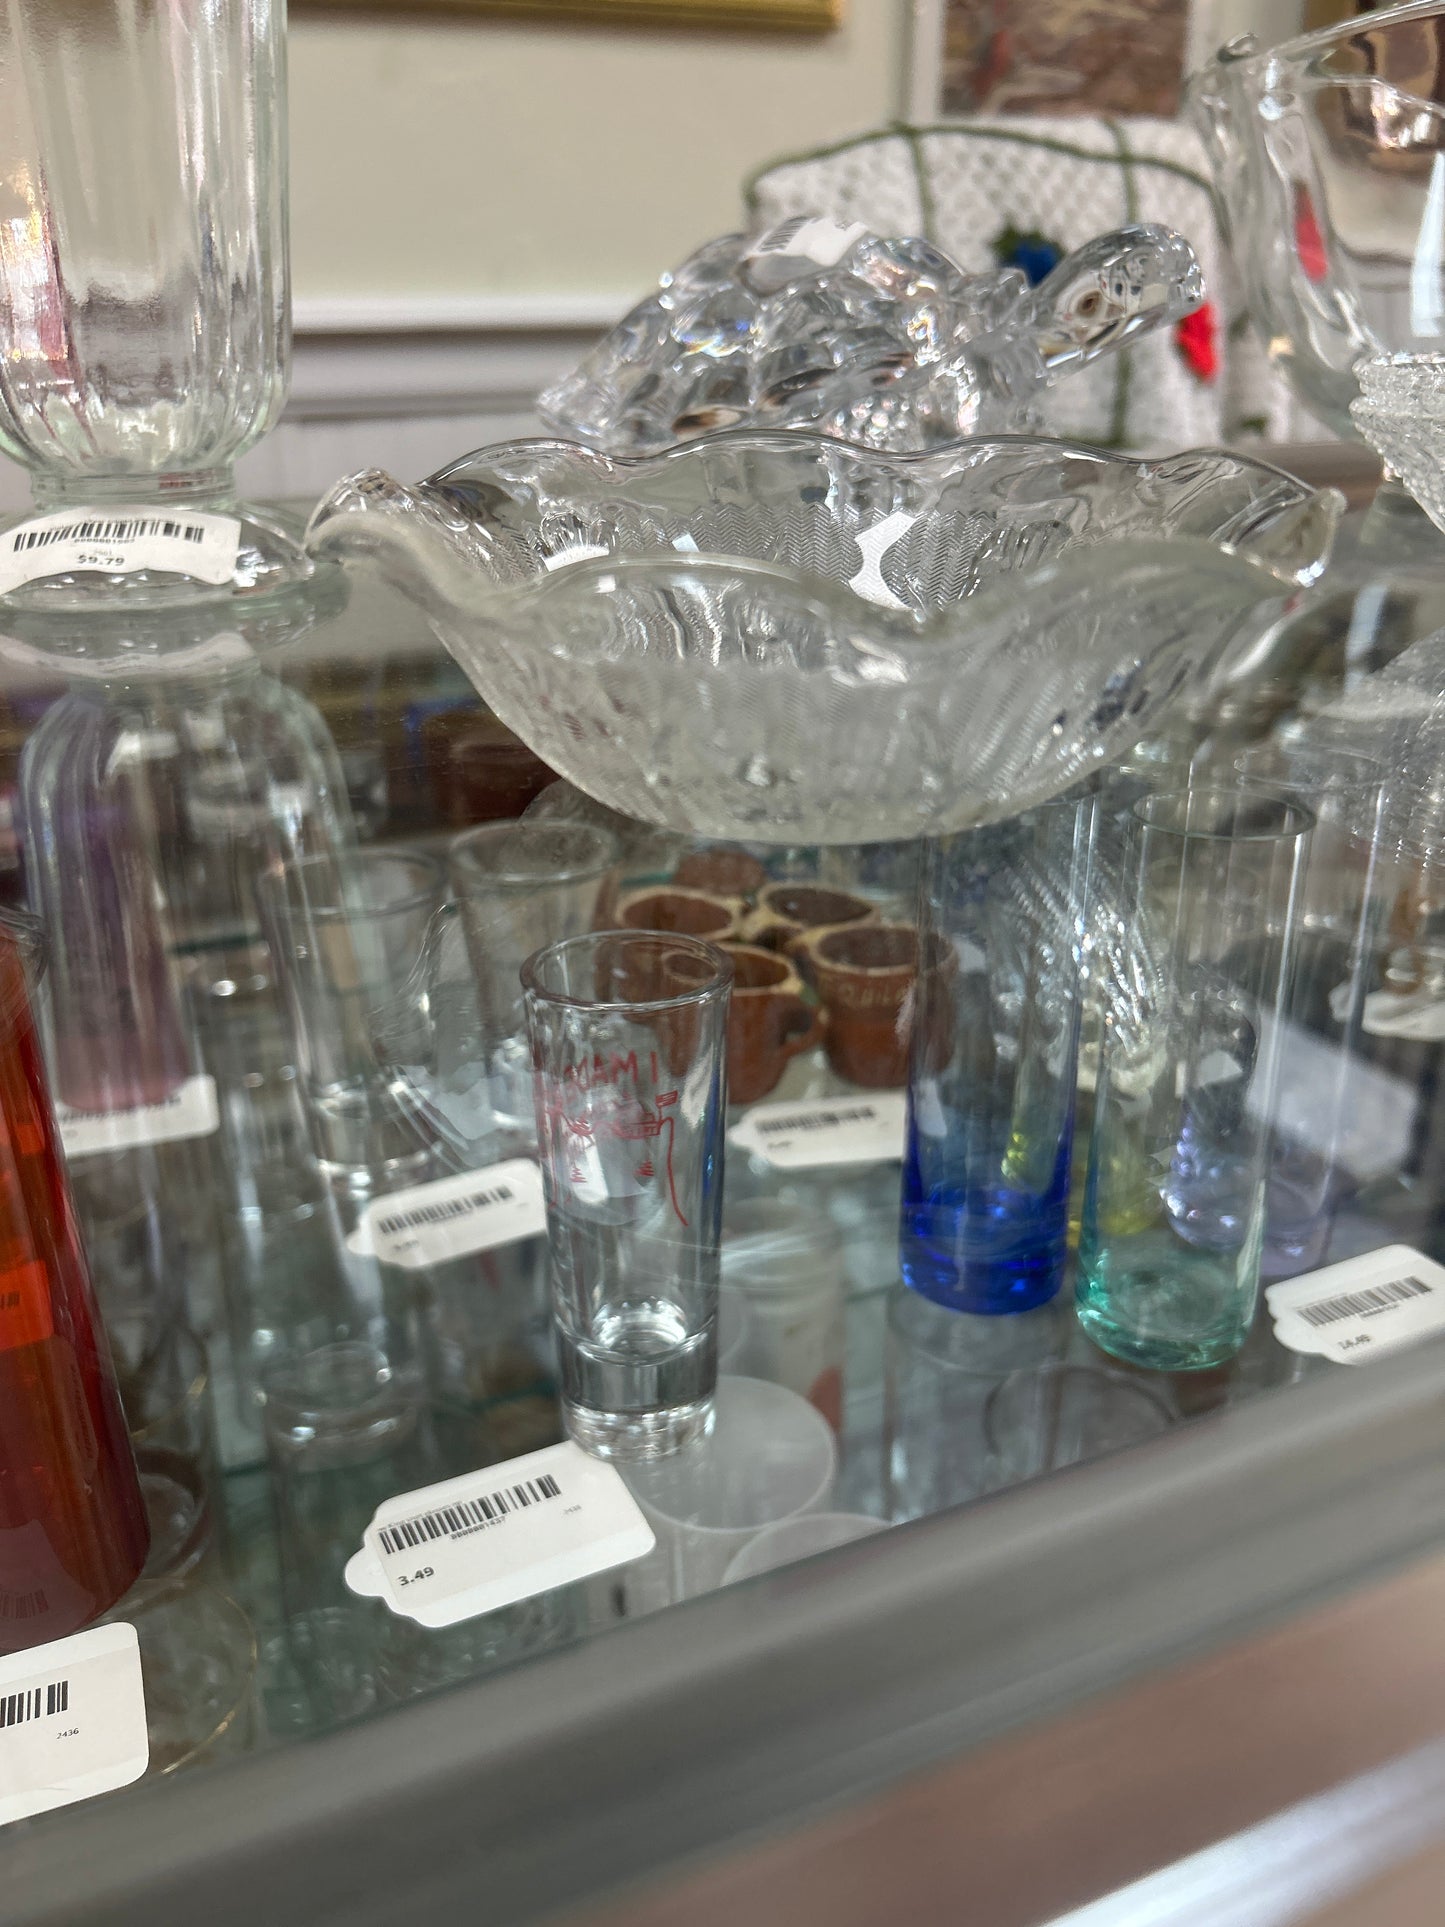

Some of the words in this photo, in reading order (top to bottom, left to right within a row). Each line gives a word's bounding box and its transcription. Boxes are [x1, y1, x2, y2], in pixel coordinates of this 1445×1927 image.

[77, 554, 125, 567] $9.79
[398, 1566, 435, 1587] 3.49
[56, 1727, 80, 1740] 2436
